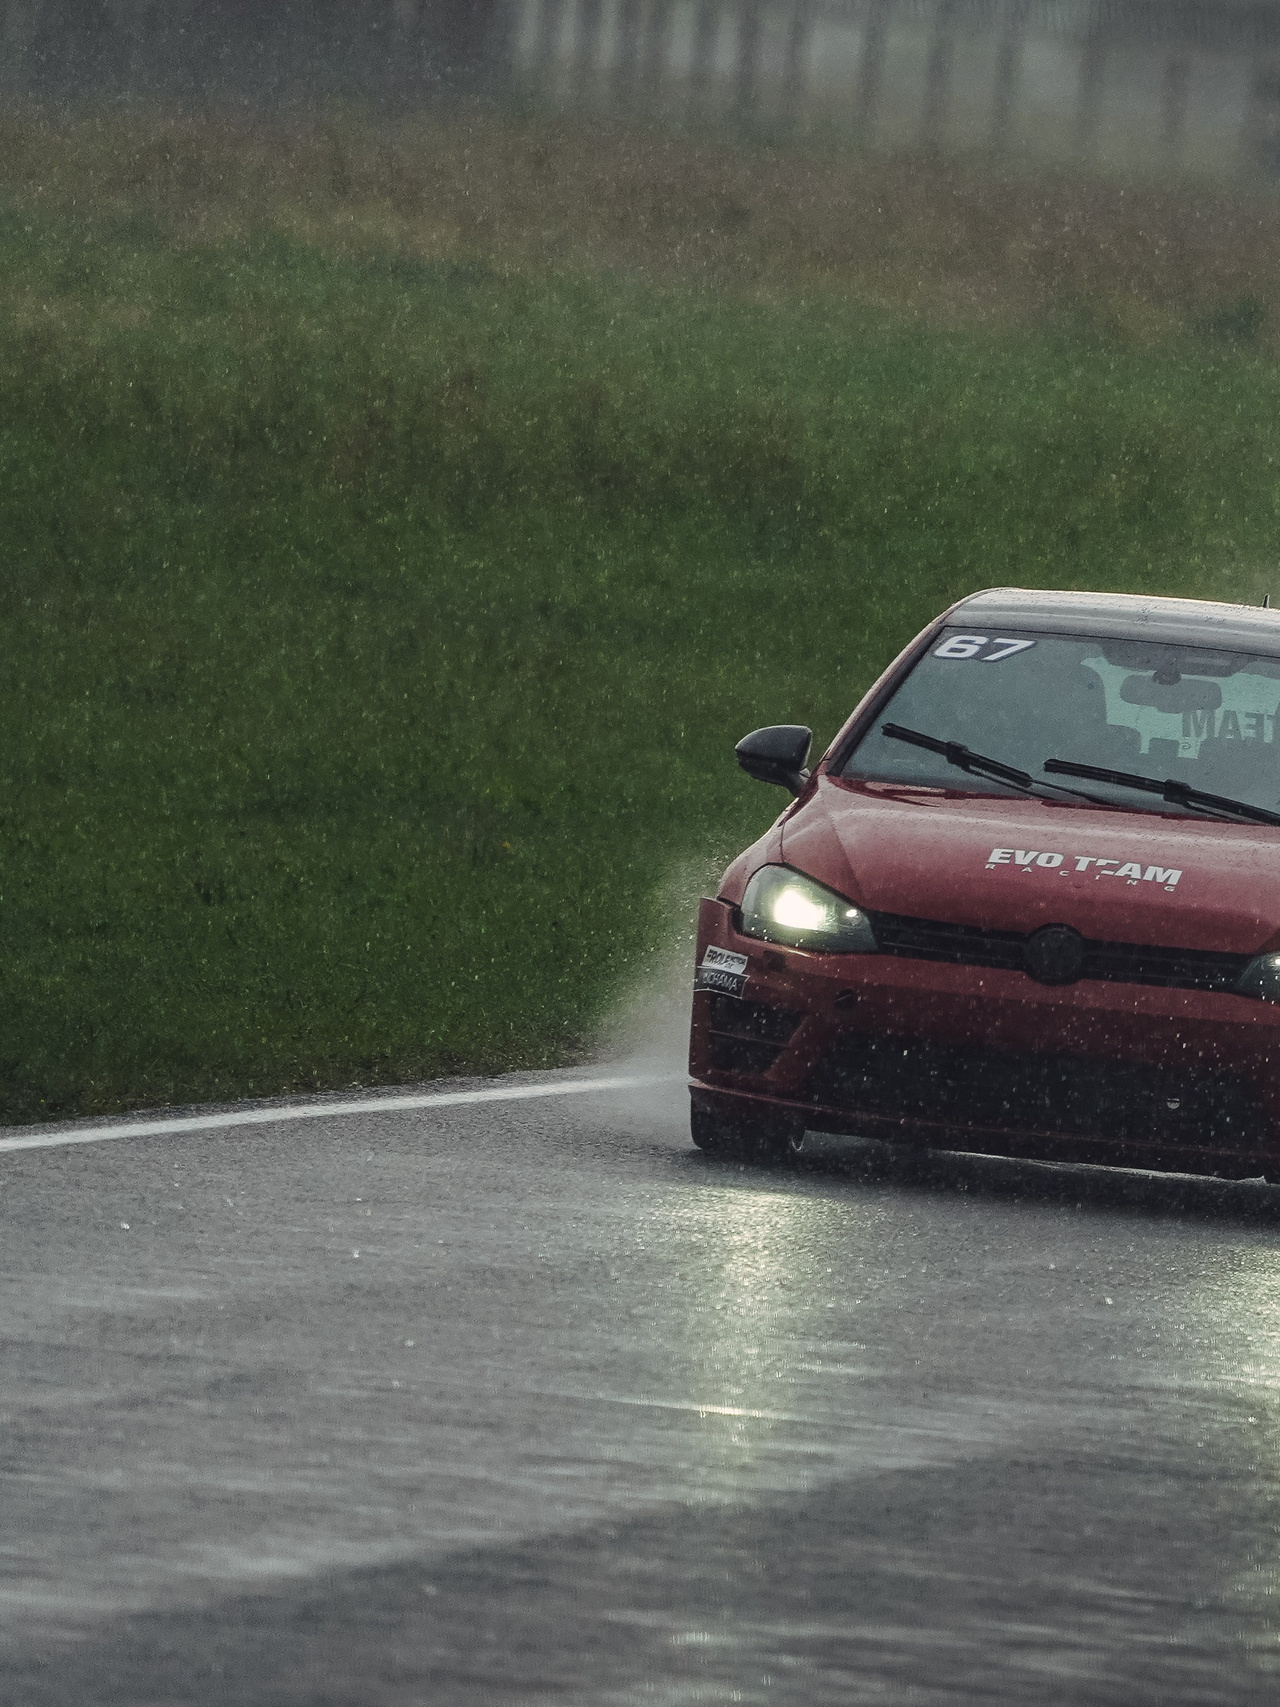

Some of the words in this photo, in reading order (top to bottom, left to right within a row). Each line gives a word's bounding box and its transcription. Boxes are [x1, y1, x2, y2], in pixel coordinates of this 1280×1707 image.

[932, 634, 1038, 661] 67
[985, 863, 1175, 892] RACING
[988, 848, 1064, 868] EVO
[1074, 856, 1183, 885] TEAM
